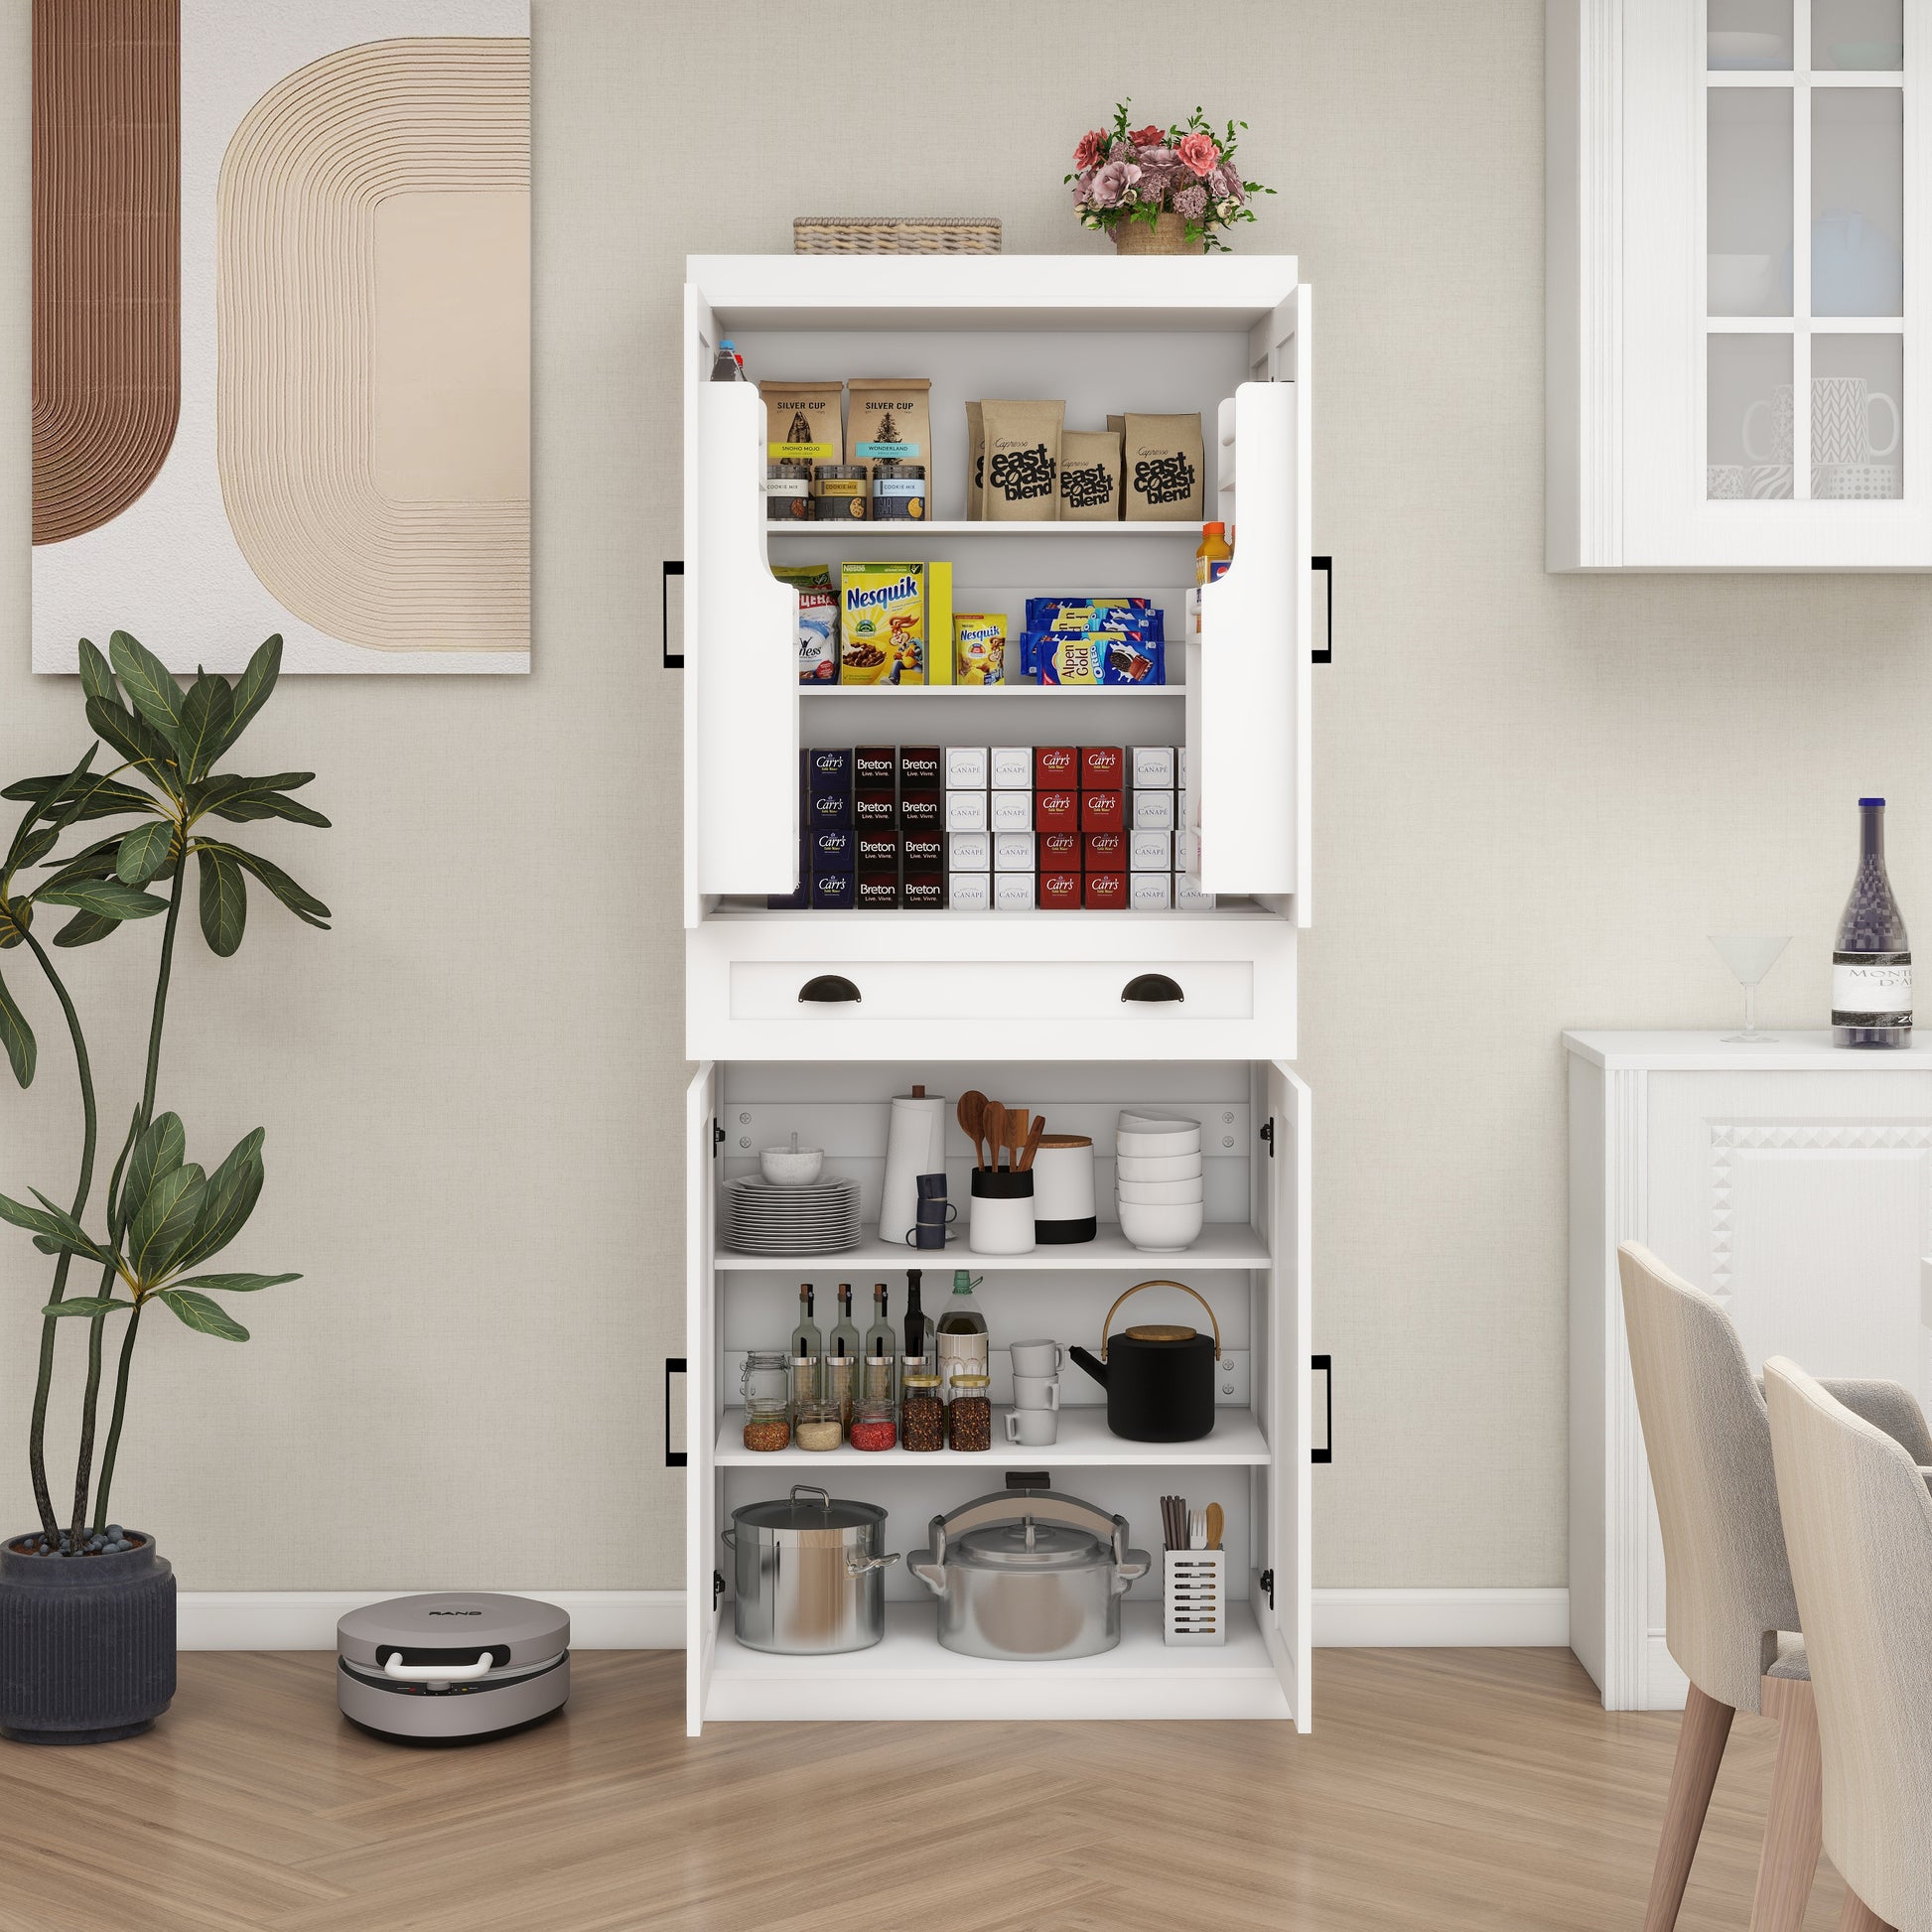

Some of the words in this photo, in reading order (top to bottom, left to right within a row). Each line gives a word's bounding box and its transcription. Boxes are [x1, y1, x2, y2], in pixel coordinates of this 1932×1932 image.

[777, 401, 806, 410] SILVER
[808, 401, 826, 410] CUP
[992, 444, 1047, 472] east
[1135, 452, 1186, 477] east
[990, 458, 1056, 488] coast
[1060, 464, 1106, 484] east
[1134, 465, 1195, 492] coast
[1005, 479, 1051, 500] blend
[1060, 475, 1113, 497] coast
[1070, 490, 1110, 508] blend
[1147, 483, 1190, 504] blend
[847, 576, 917, 611] Nesquik
[960, 625, 1000, 641] Nesquik
[1061, 645, 1078, 679] Alpen
[1075, 648, 1089, 676] Gold
[816, 756, 843, 767] Carr's
[857, 759, 893, 769] Breton
[902, 759, 937, 769] Breton
[1042, 754, 1070, 765] Carr's
[1088, 754, 1116, 765] Carr's
[816, 798, 843, 810] Carr's
[857, 801, 893, 812] Breton
[902, 801, 937, 812] Breton
[1042, 797, 1070, 808] Carr's
[1088, 797, 1116, 808] Carr's
[819, 835, 846, 847] Carr's
[860, 841, 896, 852] Breton
[905, 841, 940, 852] Breton
[1046, 836, 1074, 848] Carr's
[1092, 836, 1119, 848] Carr's
[819, 878, 846, 890] Carr's
[860, 884, 896, 895] Breton
[905, 884, 940, 895] Breton
[1046, 879, 1074, 891] Carr's
[1092, 879, 1119, 891] Carr's
